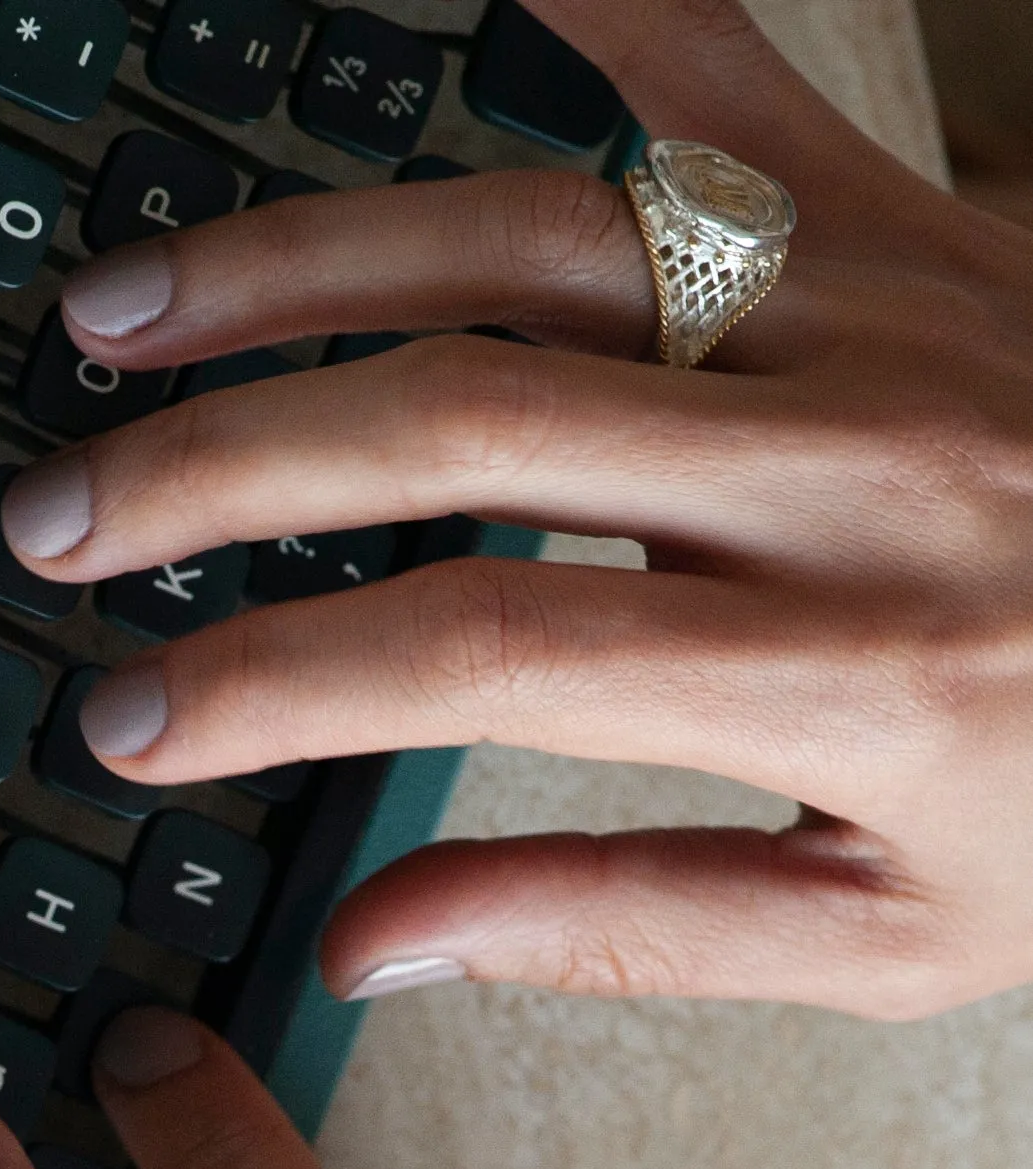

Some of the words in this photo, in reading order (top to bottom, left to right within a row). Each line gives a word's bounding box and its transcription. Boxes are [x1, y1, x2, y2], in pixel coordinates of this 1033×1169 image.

[189, 19, 214, 43] +
[244, 39, 271, 69] =
[140, 186, 179, 228] P
[153, 563, 204, 601] K
[174, 861, 222, 905] N
[26, 889, 75, 932] H
